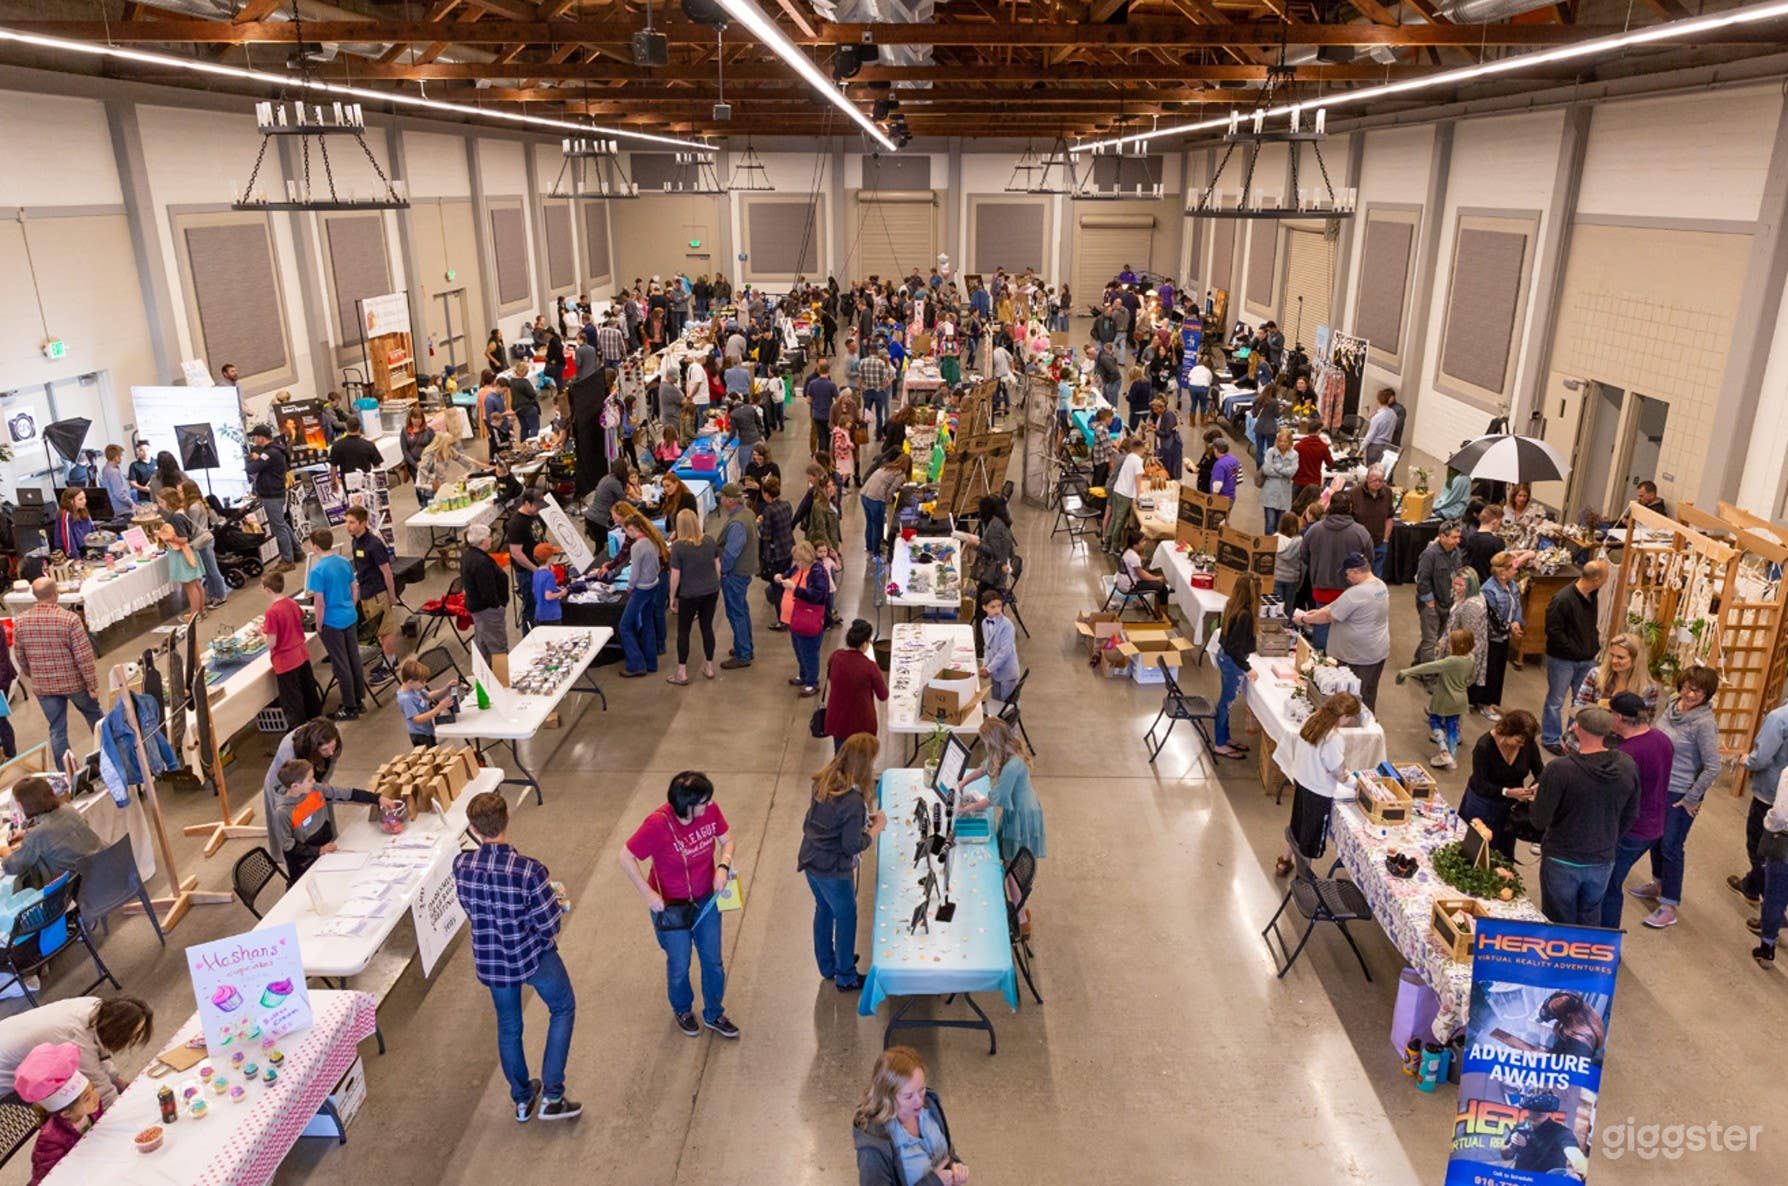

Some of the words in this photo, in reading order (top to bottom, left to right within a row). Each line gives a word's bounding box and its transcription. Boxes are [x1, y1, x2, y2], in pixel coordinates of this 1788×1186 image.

[1478, 933, 1615, 962] HEROES
[1478, 955, 1512, 963] VIRTUAL
[1516, 958, 1551, 967] REALITY
[1554, 962, 1613, 975] ADVENTURES
[1469, 1044, 1591, 1075] ADVENTURE
[1489, 1065, 1570, 1090] AWAITS
[1453, 1136, 1485, 1150] RTUAL
